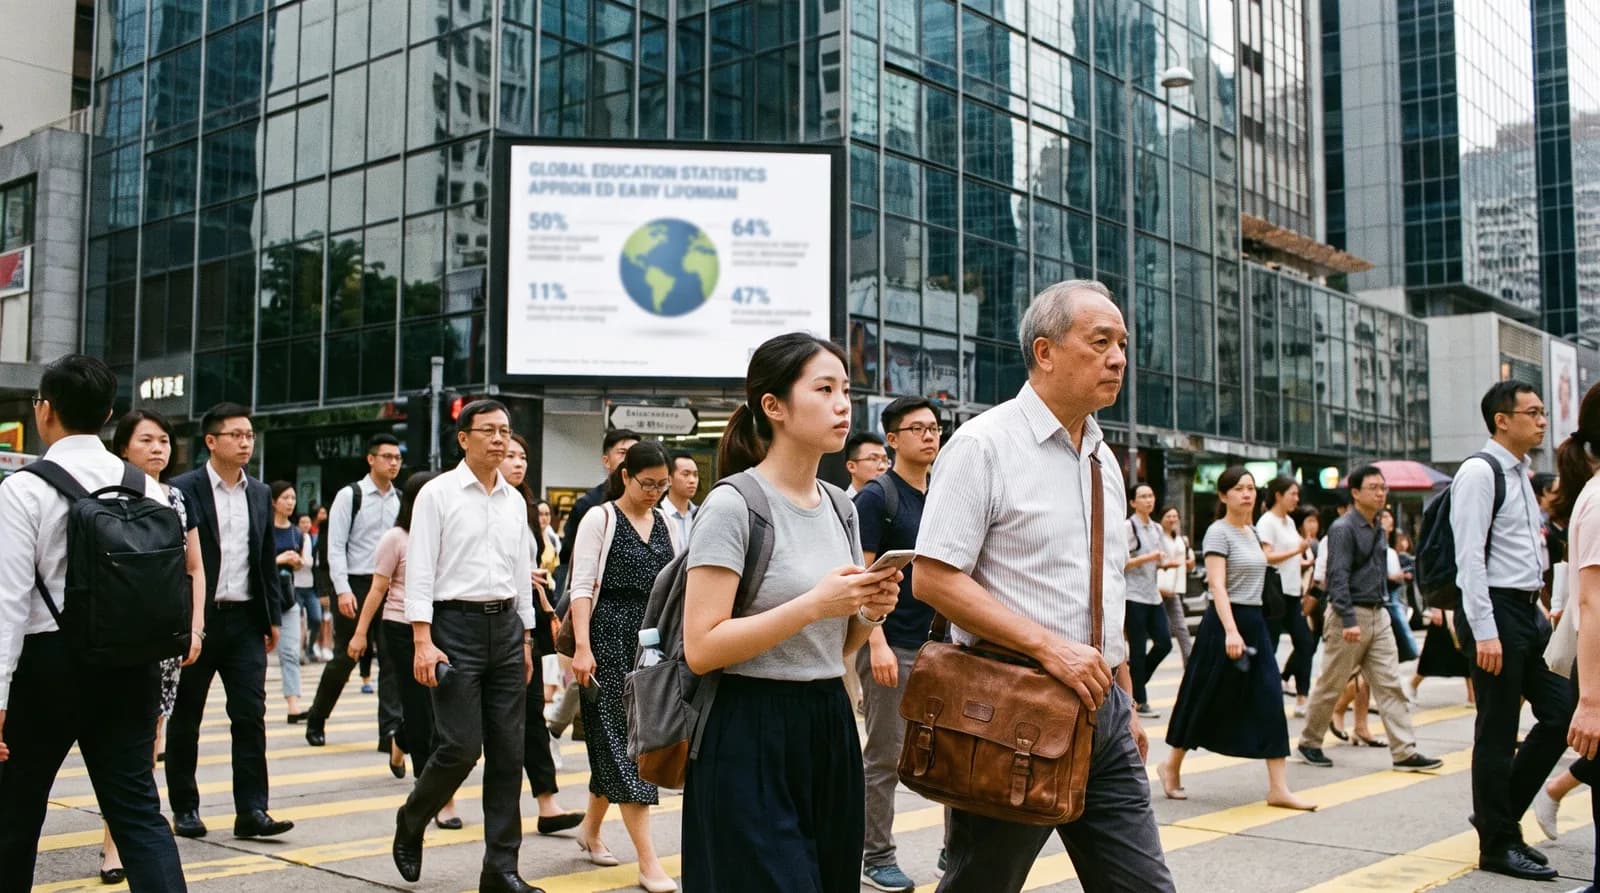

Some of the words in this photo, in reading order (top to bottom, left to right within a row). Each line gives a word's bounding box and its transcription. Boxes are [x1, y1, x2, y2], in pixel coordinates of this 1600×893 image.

[529, 162, 588, 177] GLOBAL
[592, 163, 677, 180] EDUCATION
[681, 165, 767, 183] STATISTICS
[529, 212, 568, 231] 50%
[732, 219, 771, 237] 64%
[529, 282, 567, 300] 11%
[731, 287, 771, 305] 47%
